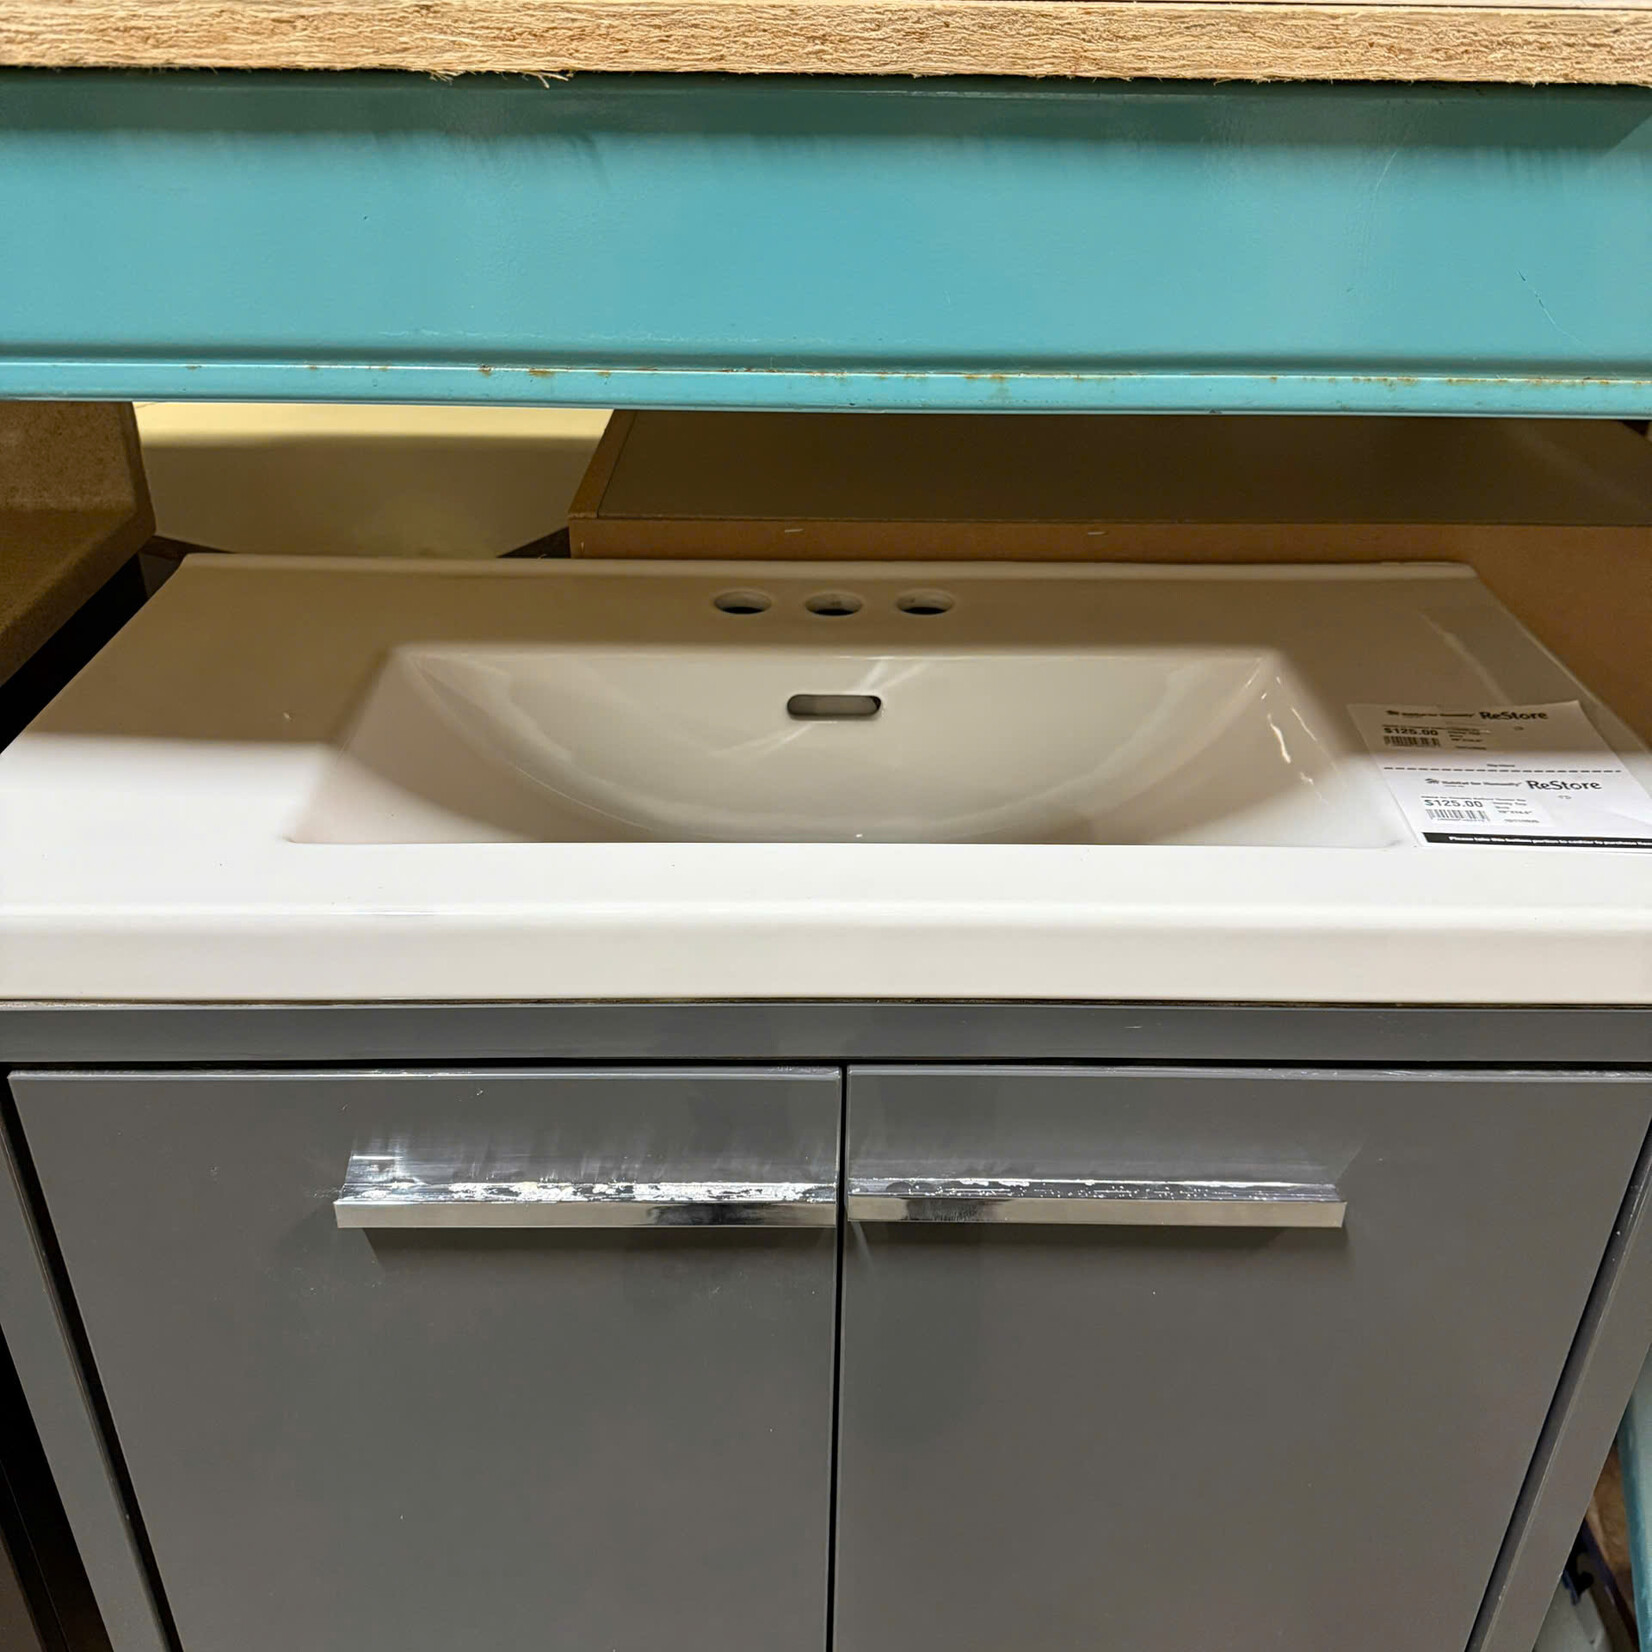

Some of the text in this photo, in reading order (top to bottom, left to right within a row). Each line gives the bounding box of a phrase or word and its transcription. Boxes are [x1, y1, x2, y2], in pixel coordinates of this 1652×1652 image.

[1479, 711, 1548, 720] ReStore
[1384, 727, 1439, 736] $125.00
[1526, 779, 1602, 790] ReStore
[1424, 799, 1483, 808] $125.00
